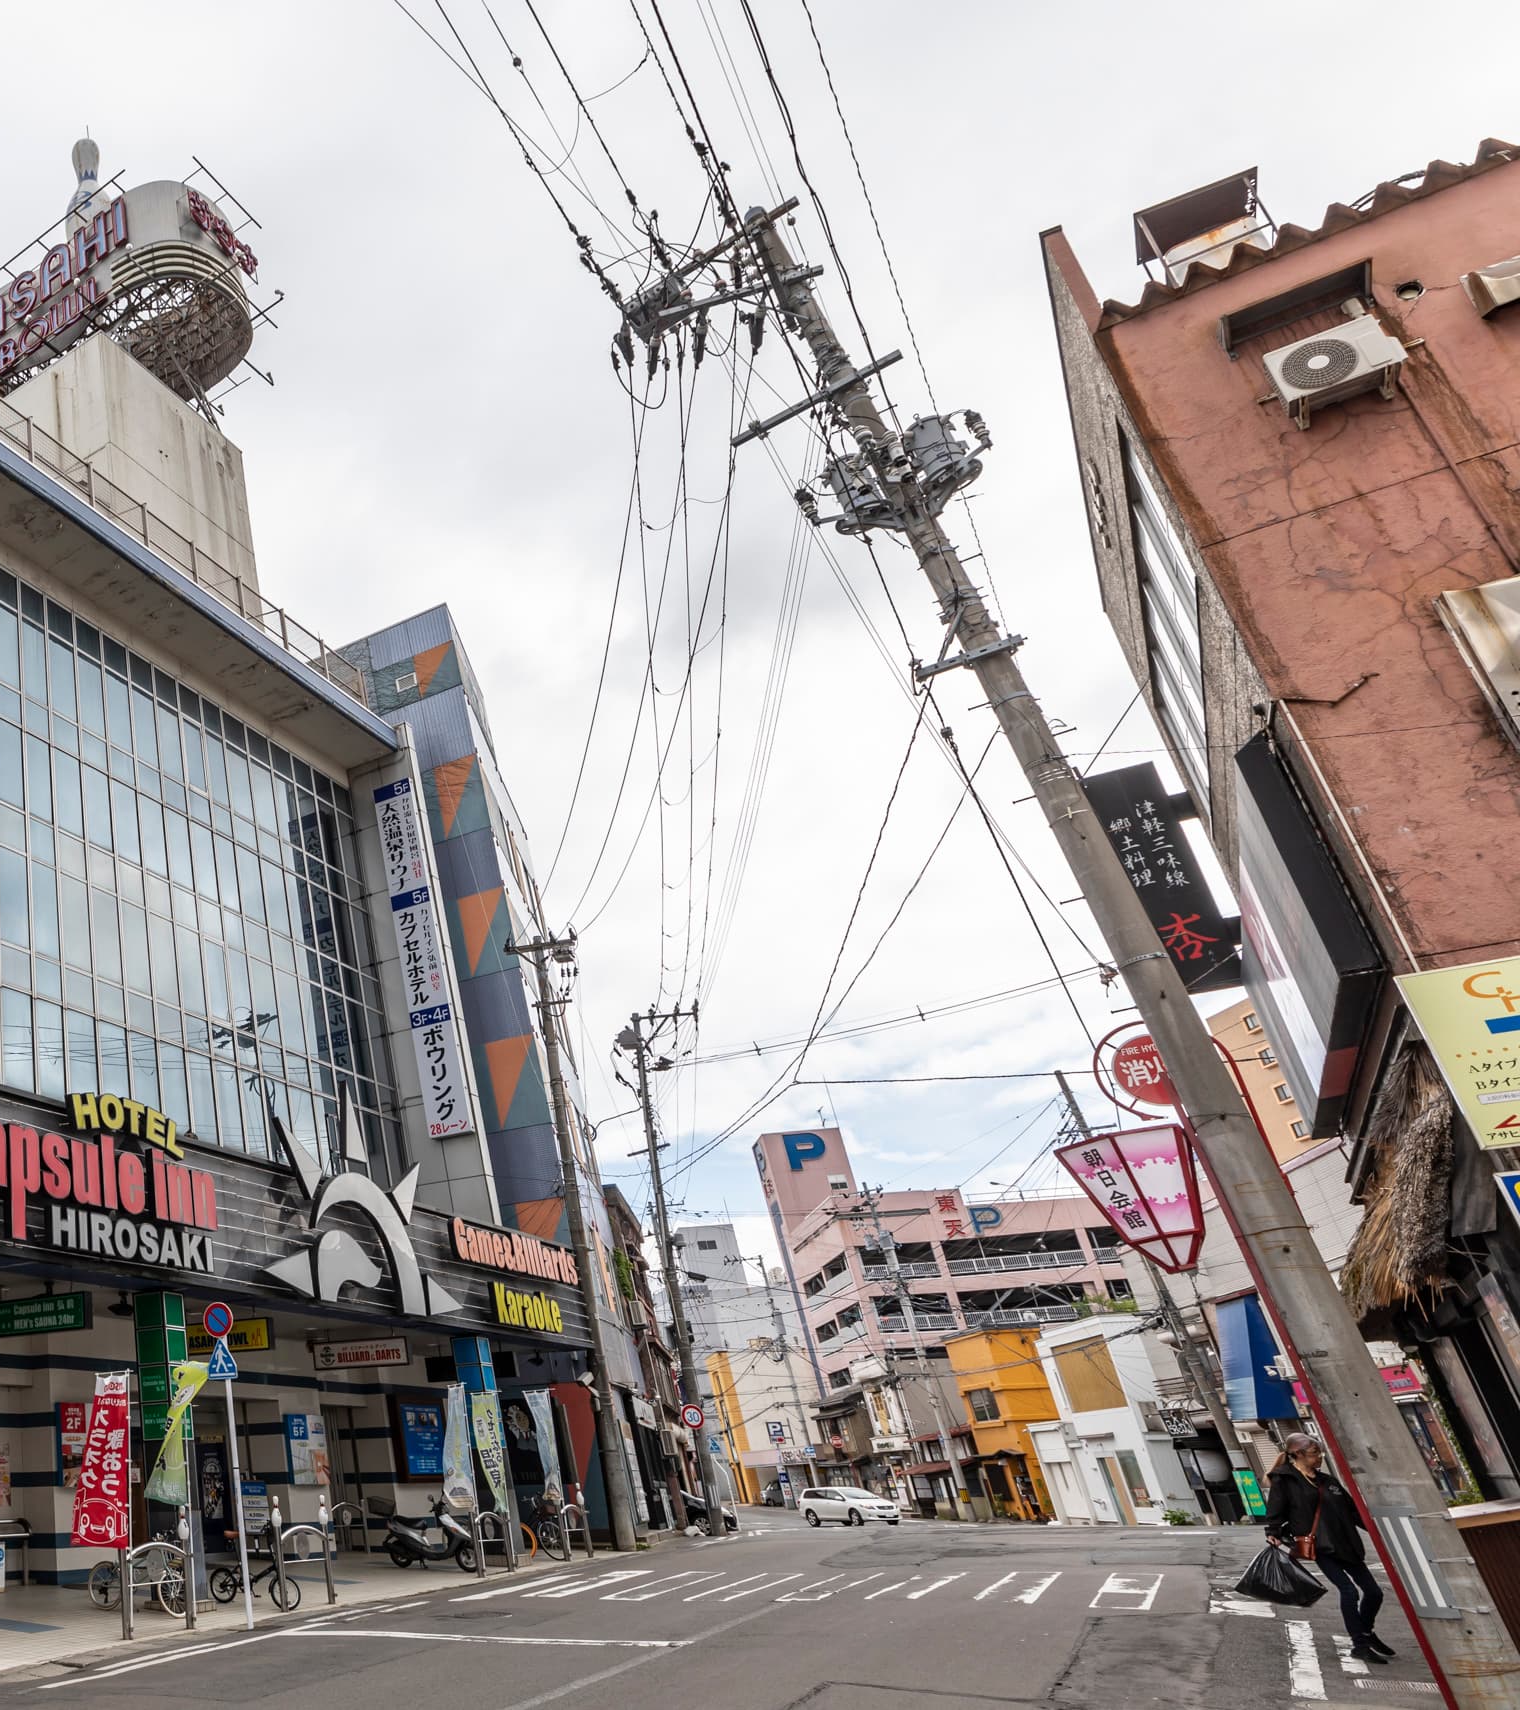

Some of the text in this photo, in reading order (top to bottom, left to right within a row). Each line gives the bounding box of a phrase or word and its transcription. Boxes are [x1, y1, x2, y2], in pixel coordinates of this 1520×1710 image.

[393, 782, 409, 796] 5F
[379, 800, 410, 892] 天然温泉サウナ
[1107, 816, 1157, 888] 郷土料理
[1134, 799, 1191, 889] 津軽三味線
[411, 889, 428, 904] 5F
[398, 911, 430, 1006] カプセルホテル
[422, 1023, 456, 1122] ボウリング
[1120, 1045, 1141, 1056] FIRE
[70, 1093, 185, 1159] HOTEL
[429, 1119, 468, 1136] 28レーン
[782, 1132, 826, 1172] P
[150, 1149, 219, 1232] inn
[1081, 1148, 1148, 1230] 朝日会館
[50, 1205, 215, 1273] HIROSAKI
[935, 1194, 966, 1237] 東天
[492, 1281, 564, 1334] Karaoke
[337, 1350, 370, 1363] BILLIARD
[375, 1348, 401, 1361] DARTS
[66, 1416, 82, 1430] 2F
[685, 1410, 700, 1422] 30
[767, 1422, 781, 1436] P
